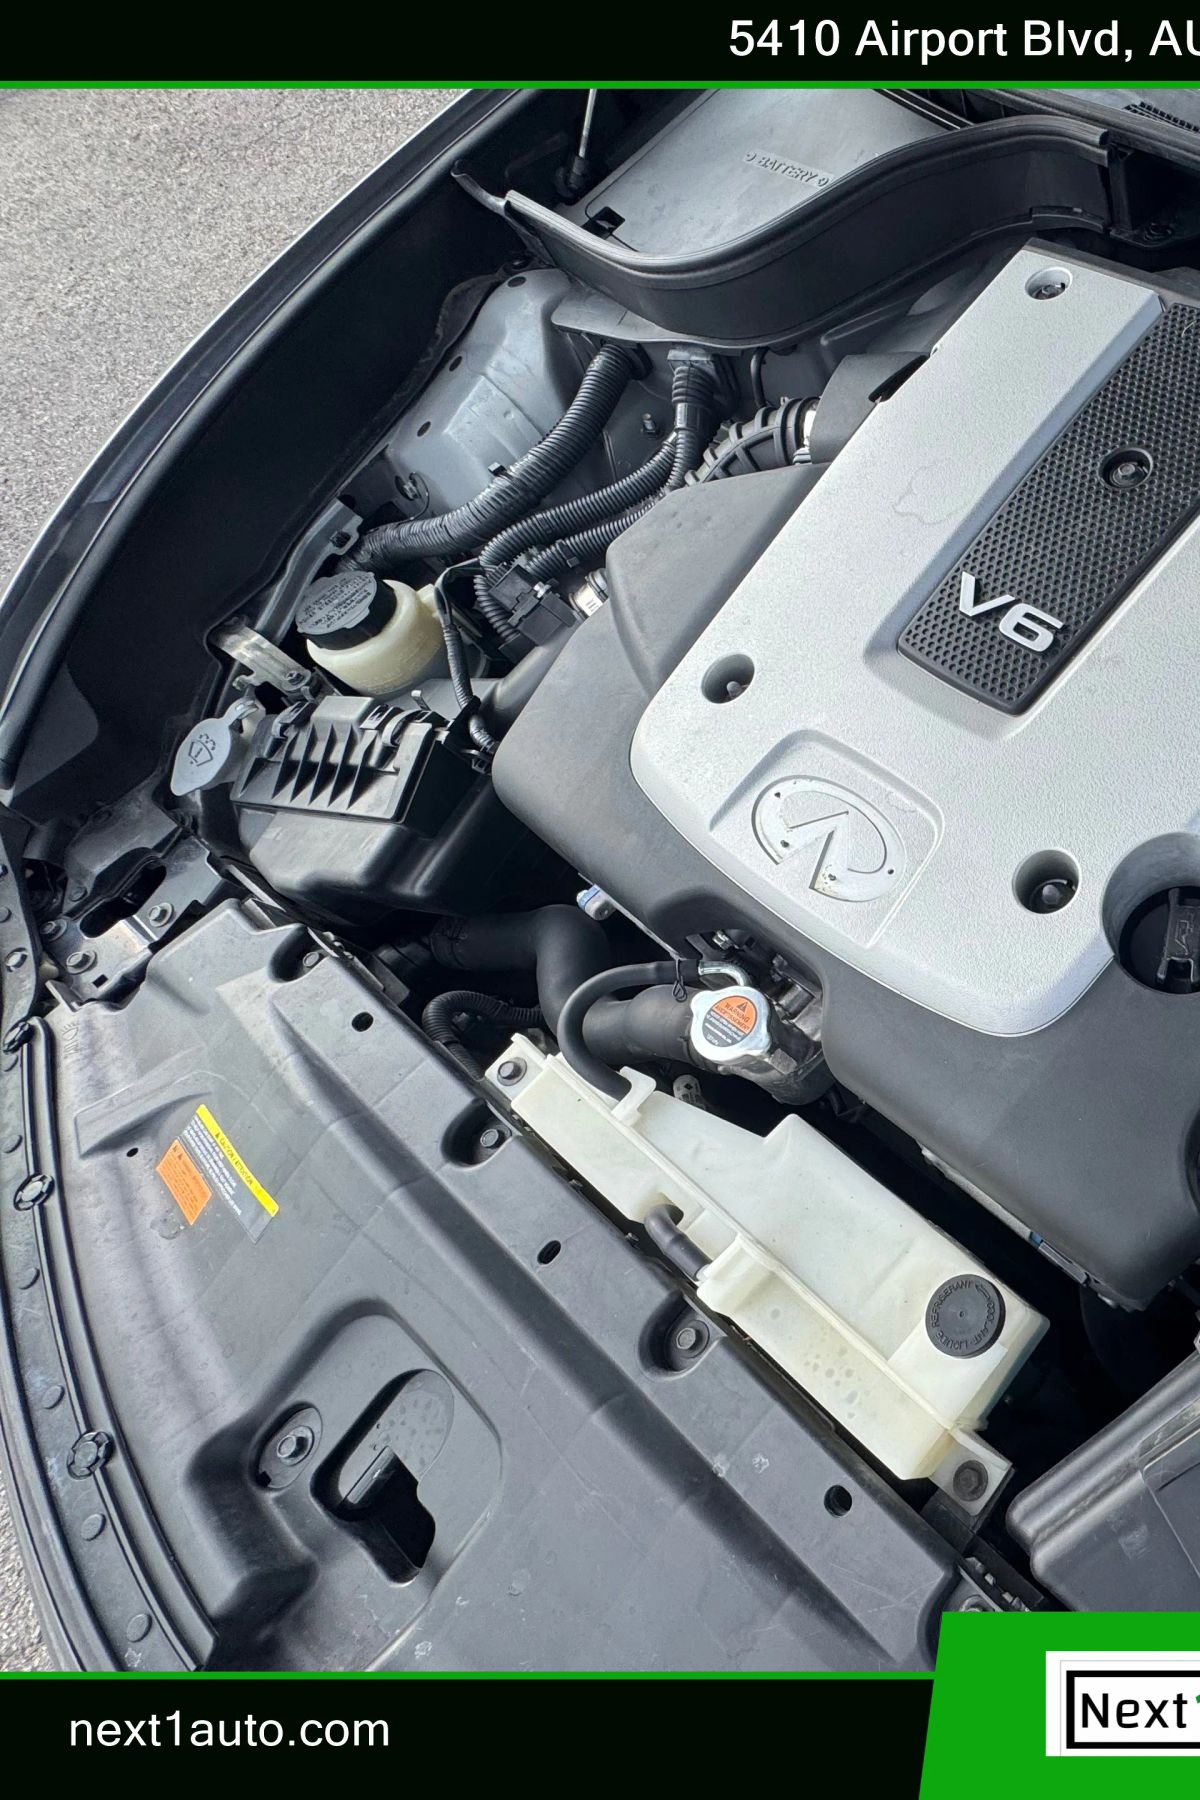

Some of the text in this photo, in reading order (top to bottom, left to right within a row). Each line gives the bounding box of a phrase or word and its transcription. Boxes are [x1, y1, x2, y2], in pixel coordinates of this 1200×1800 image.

[758, 157, 819, 182] BATTERY
[959, 571, 1064, 652] V6
[725, 1003, 750, 1022] WARNING
